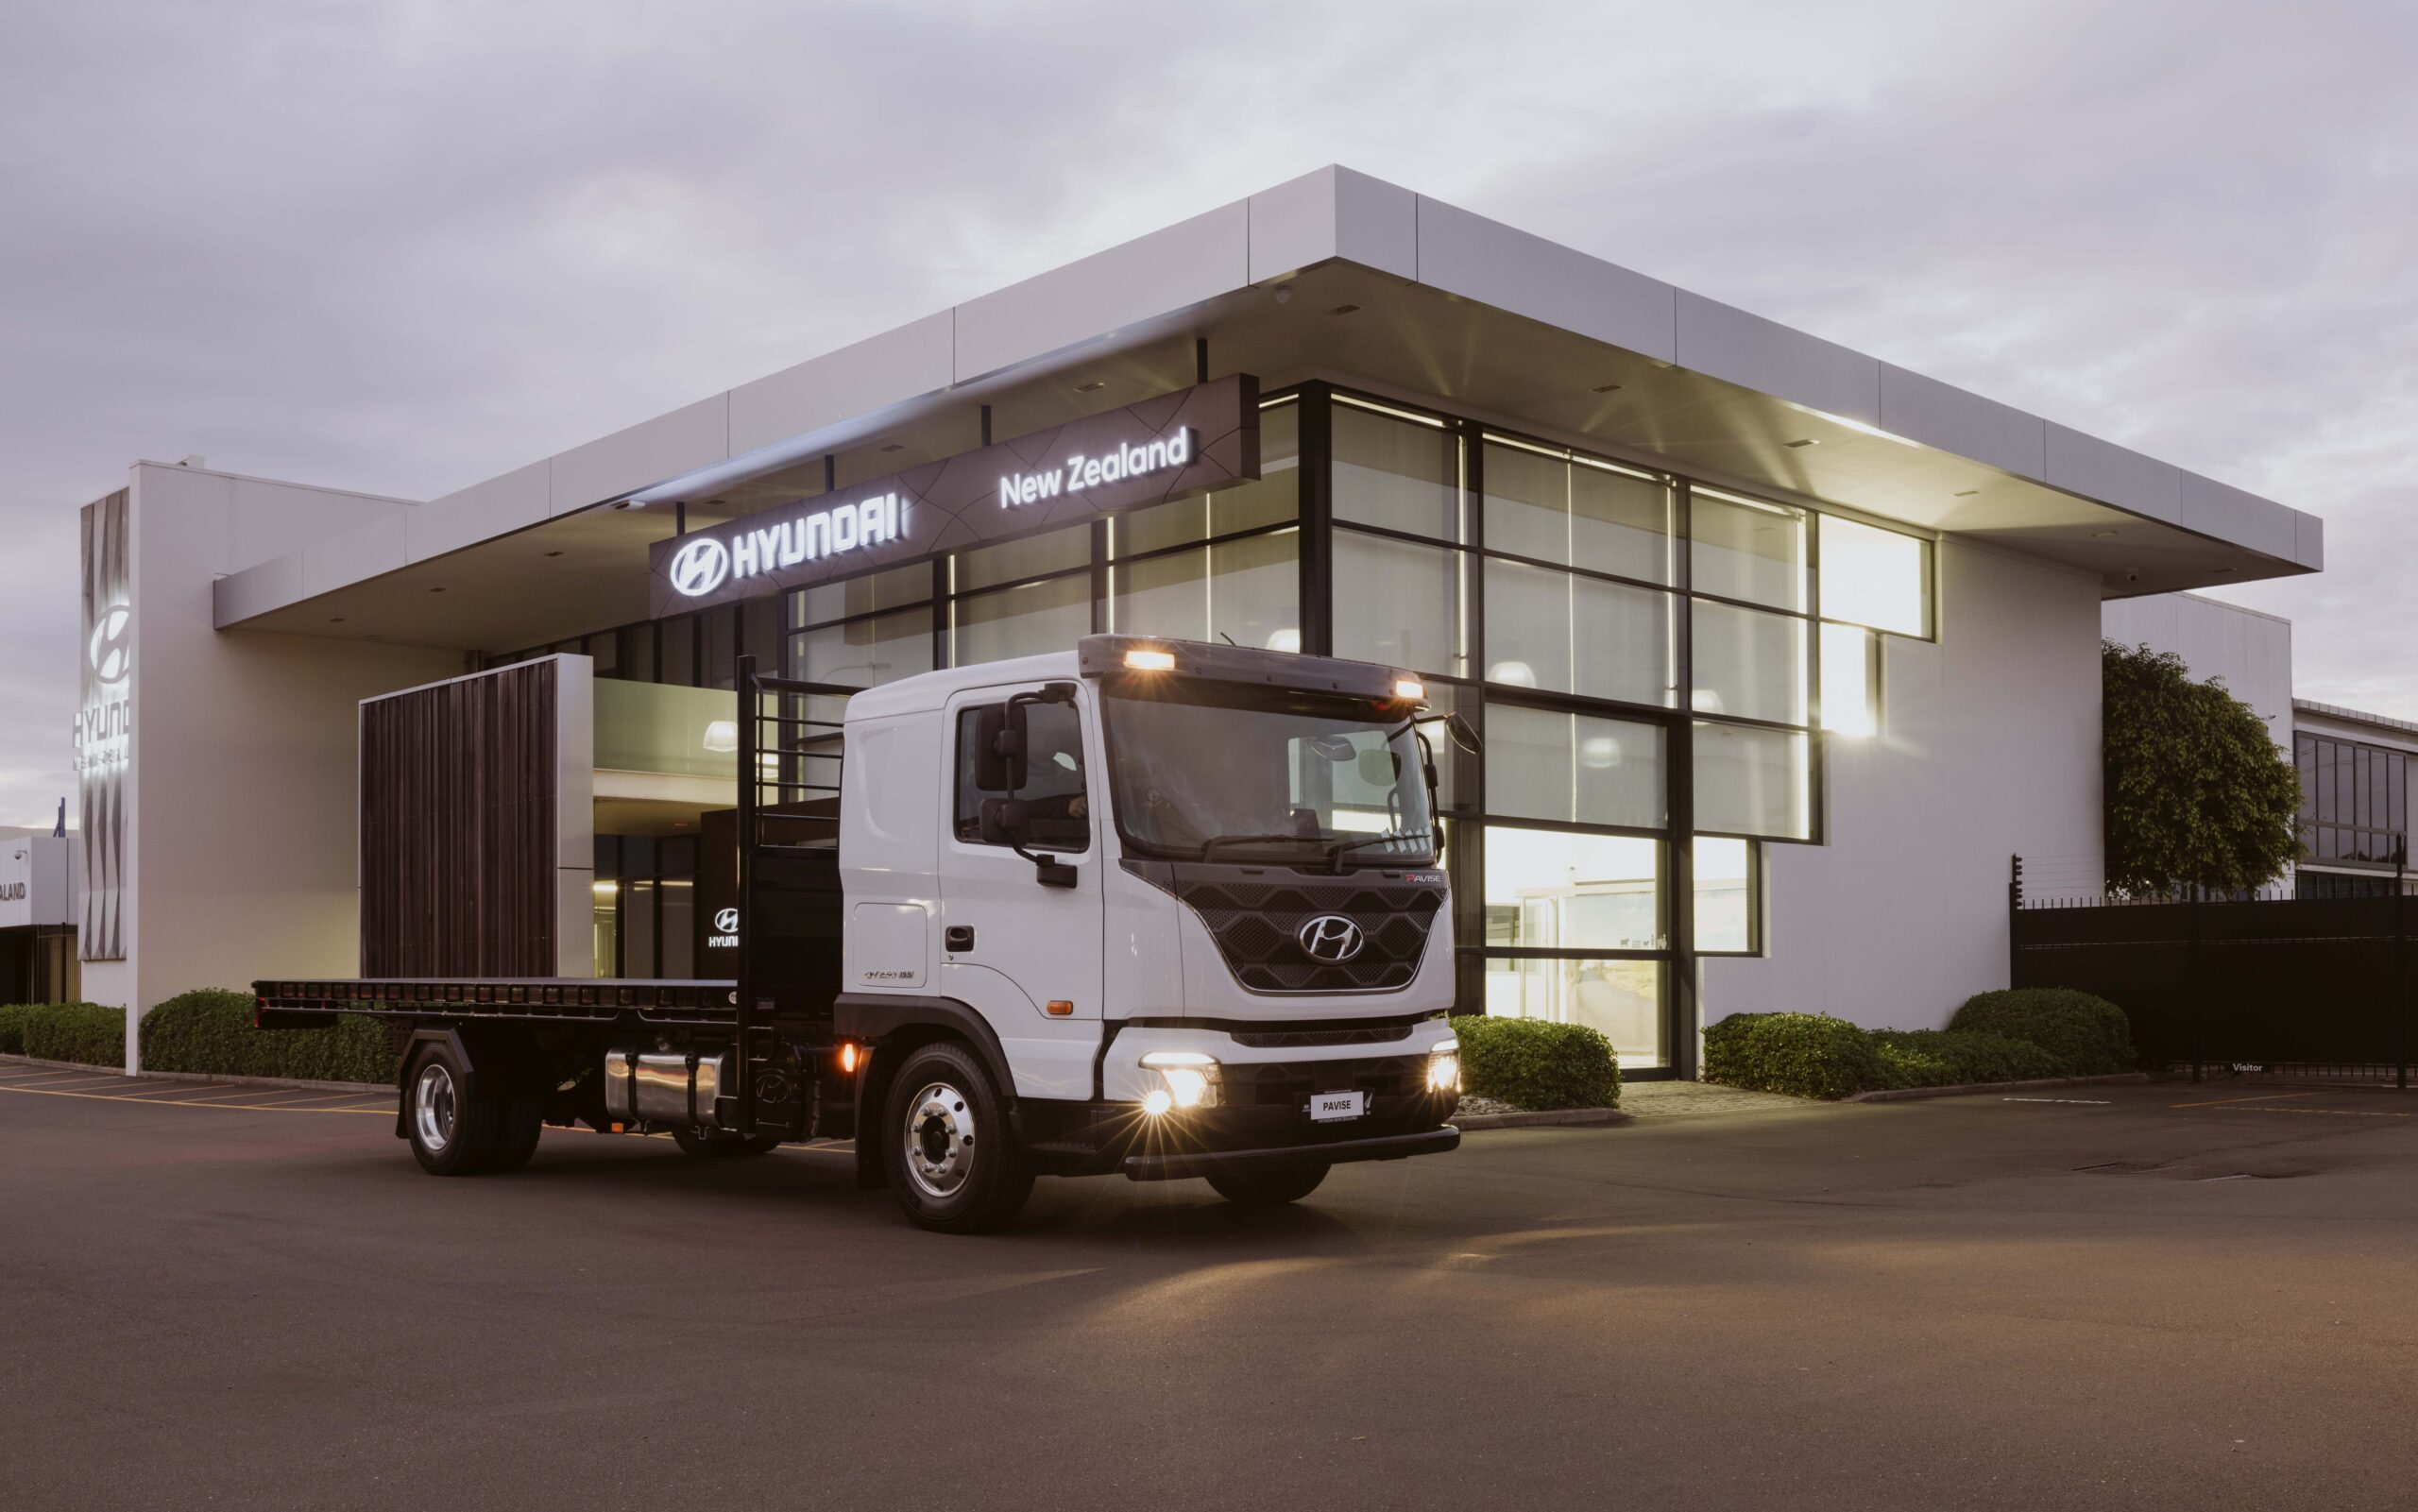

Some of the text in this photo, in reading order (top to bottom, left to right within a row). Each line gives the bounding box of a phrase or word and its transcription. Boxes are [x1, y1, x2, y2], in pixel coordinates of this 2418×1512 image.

[1000, 426, 1187, 509] New Zealand
[733, 492, 896, 578] HYUNDAI
[1405, 873, 1441, 883] PAVISE
[2233, 1062, 2263, 1072] Visitor
[1322, 1100, 1352, 1112] PAVISE
